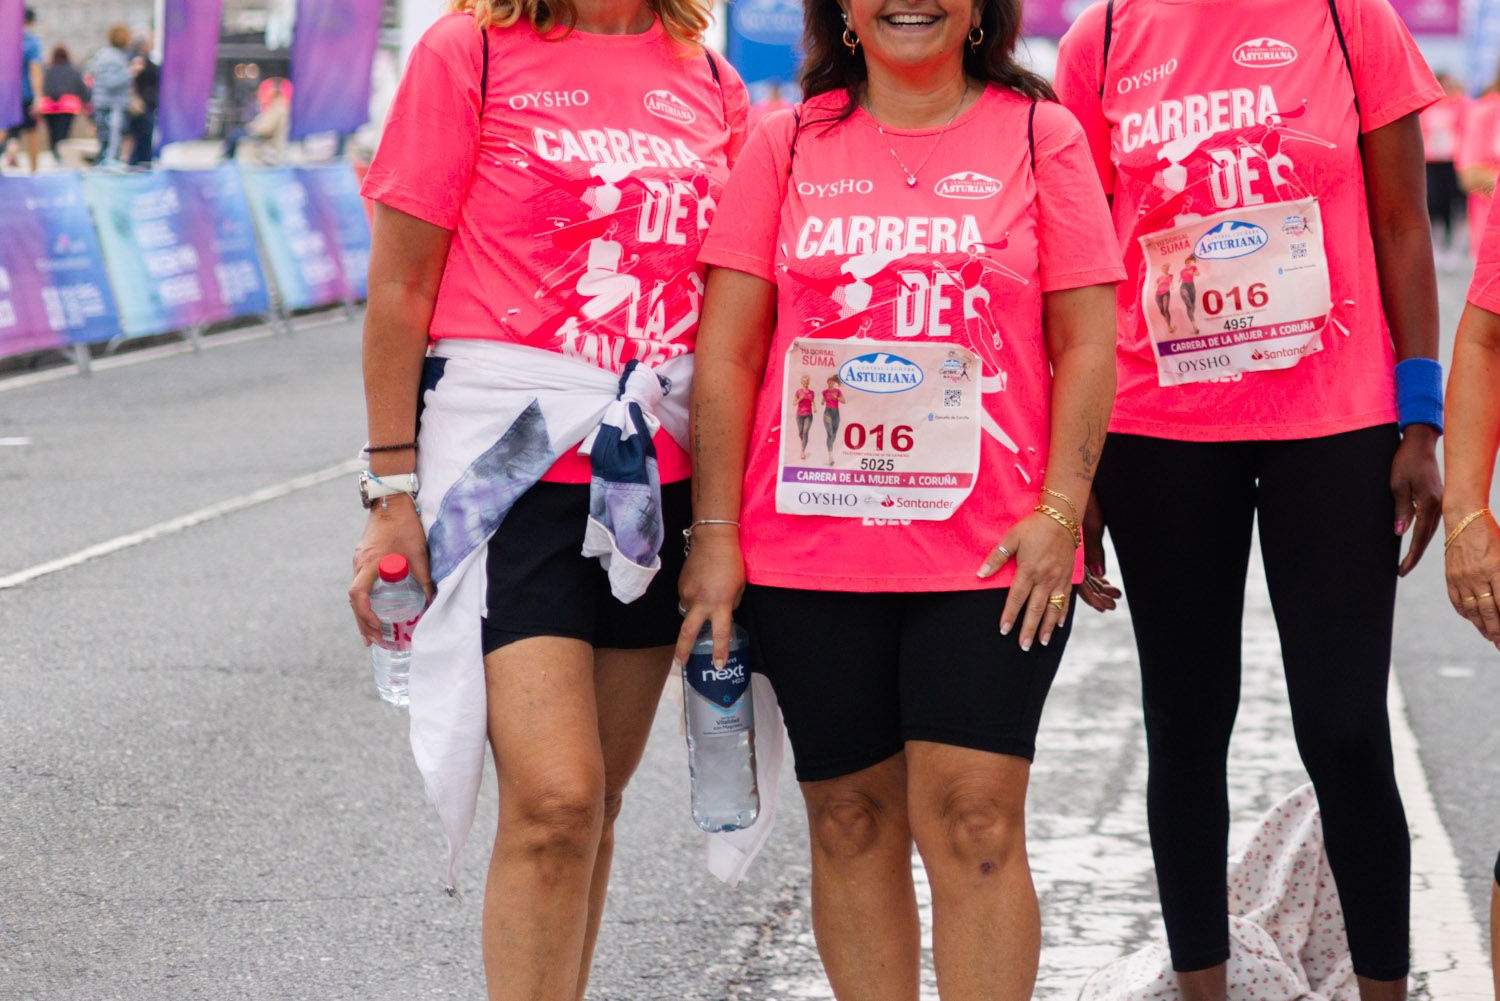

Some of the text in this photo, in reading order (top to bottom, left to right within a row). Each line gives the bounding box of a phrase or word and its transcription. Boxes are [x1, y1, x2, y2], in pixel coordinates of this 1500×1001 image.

[1238, 49, 1293, 62] ASTURIANA
[1117, 58, 1178, 95] OYSHO
[510, 89, 589, 110] OYSHO
[1121, 85, 1281, 153] CARRERA
[532, 127, 706, 171] CARRERA
[1207, 145, 1267, 209] DE
[798, 178, 873, 198] OYSHO
[940, 182, 998, 194] ASTURIANA
[635, 178, 696, 246] DE
[796, 215, 986, 260] CARRERA
[1198, 235, 1263, 257] ASTURIANA
[1160, 240, 1191, 256] SUMA
[893, 271, 957, 338] DE
[1202, 282, 1270, 316] 016
[1223, 316, 1254, 331] 4957
[1170, 320, 1315, 352] CARRERA DE LA MUJER A CORUÑA
[802, 355, 835, 368] SUMA
[1178, 354, 1231, 373] OYSHO
[845, 366, 917, 384] ASTURIANA
[844, 423, 914, 453] 016
[860, 458, 894, 471] 5025
[797, 471, 958, 486] CARRERA DE LA MUJER A CORUÑA
[798, 491, 953, 509] OYSHO Santander
[702, 664, 744, 681] next
